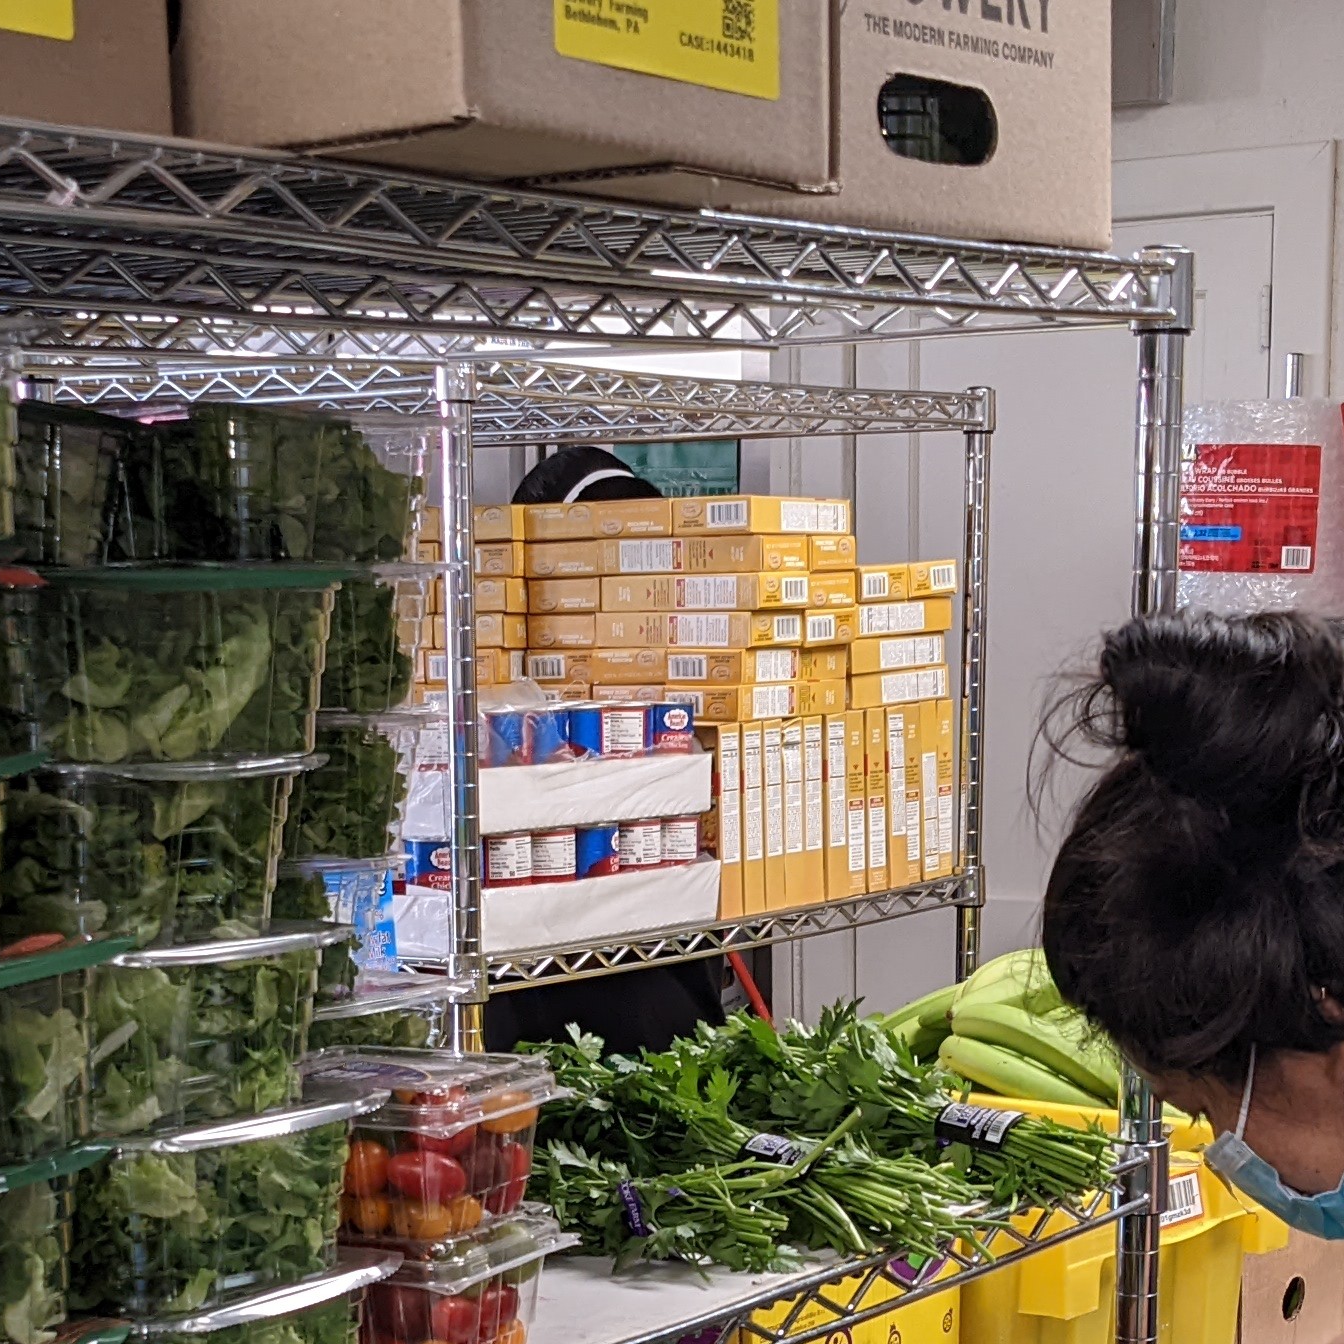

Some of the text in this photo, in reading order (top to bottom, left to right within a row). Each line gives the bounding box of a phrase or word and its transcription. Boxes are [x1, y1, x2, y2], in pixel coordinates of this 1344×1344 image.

[626, 18, 640, 35] PA
[864, 13, 890, 36] THE
[893, 19, 945, 47] MODERN
[948, 32, 999, 58] FARMING
[1002, 42, 1055, 70] COMPANY
[1207, 484, 1257, 493] ACOLCHADO
